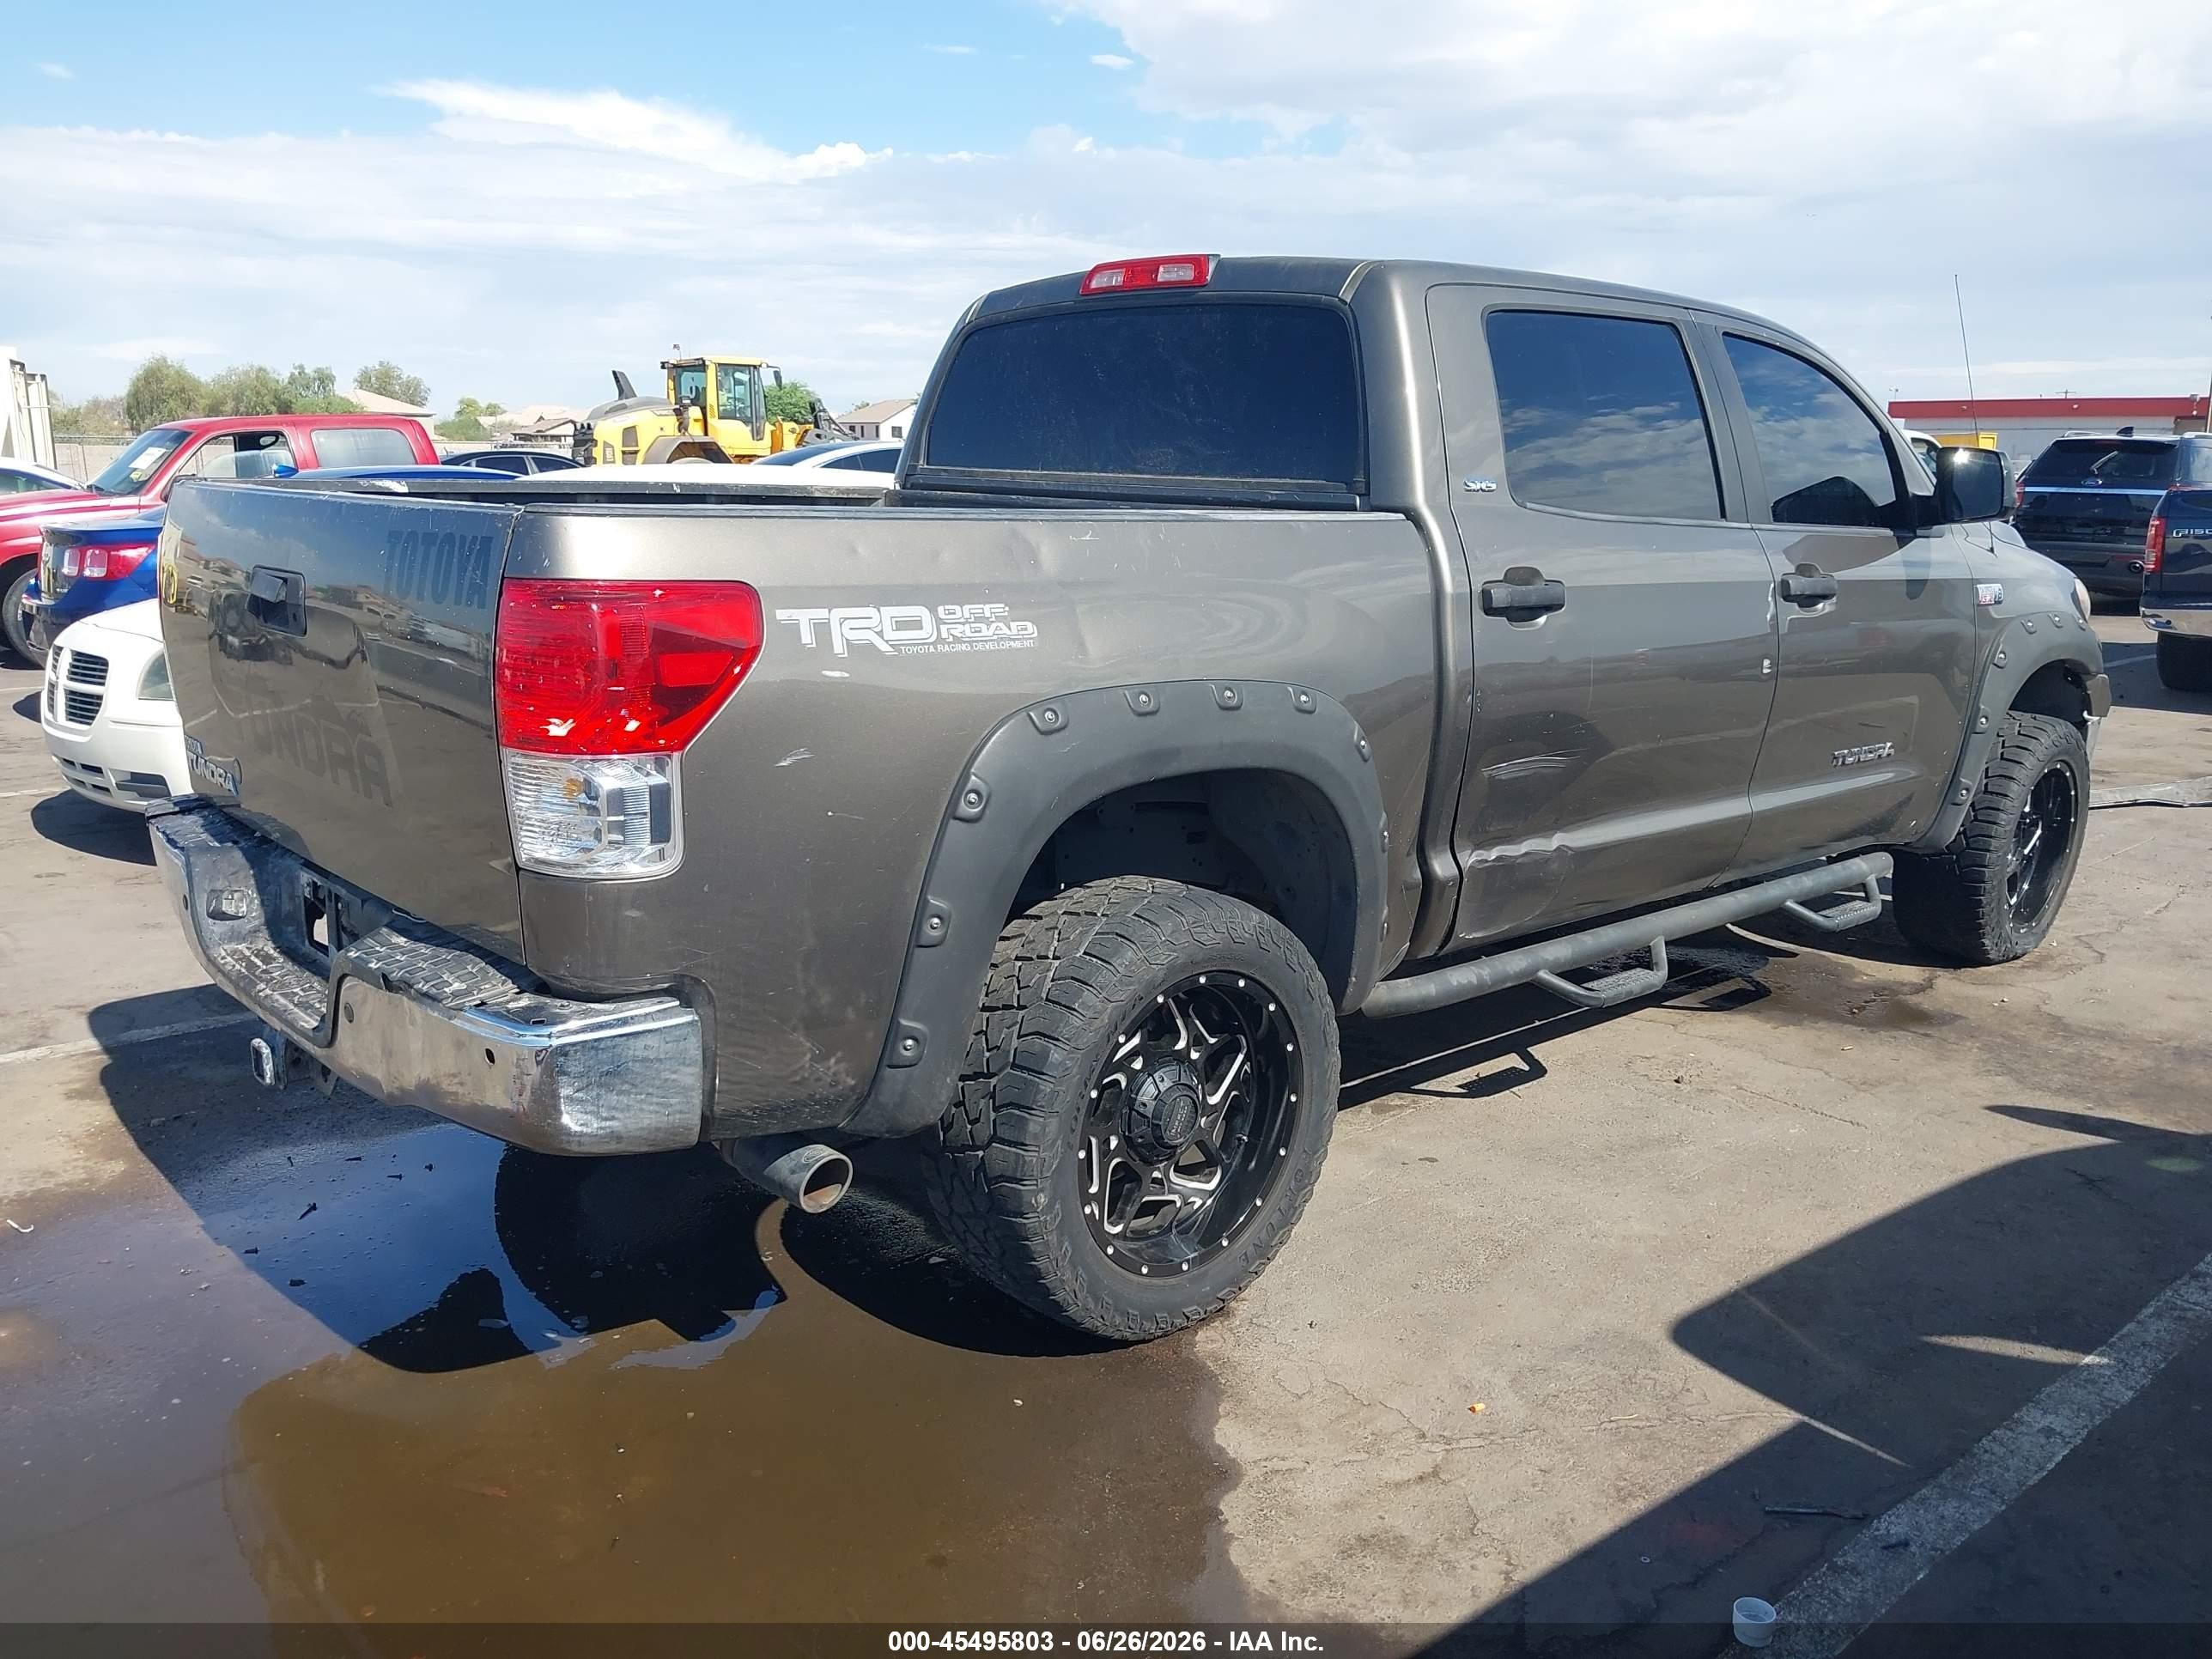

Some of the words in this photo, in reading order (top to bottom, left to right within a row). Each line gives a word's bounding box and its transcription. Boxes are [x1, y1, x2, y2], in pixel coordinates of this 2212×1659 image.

[938, 603, 1010, 623] OFF
[775, 605, 938, 658] TRD
[940, 621, 1038, 642] ROAD
[899, 645, 935, 655] TOYOTA
[937, 643, 971, 653] RACING
[972, 640, 1036, 651] DEVELOPMENT
